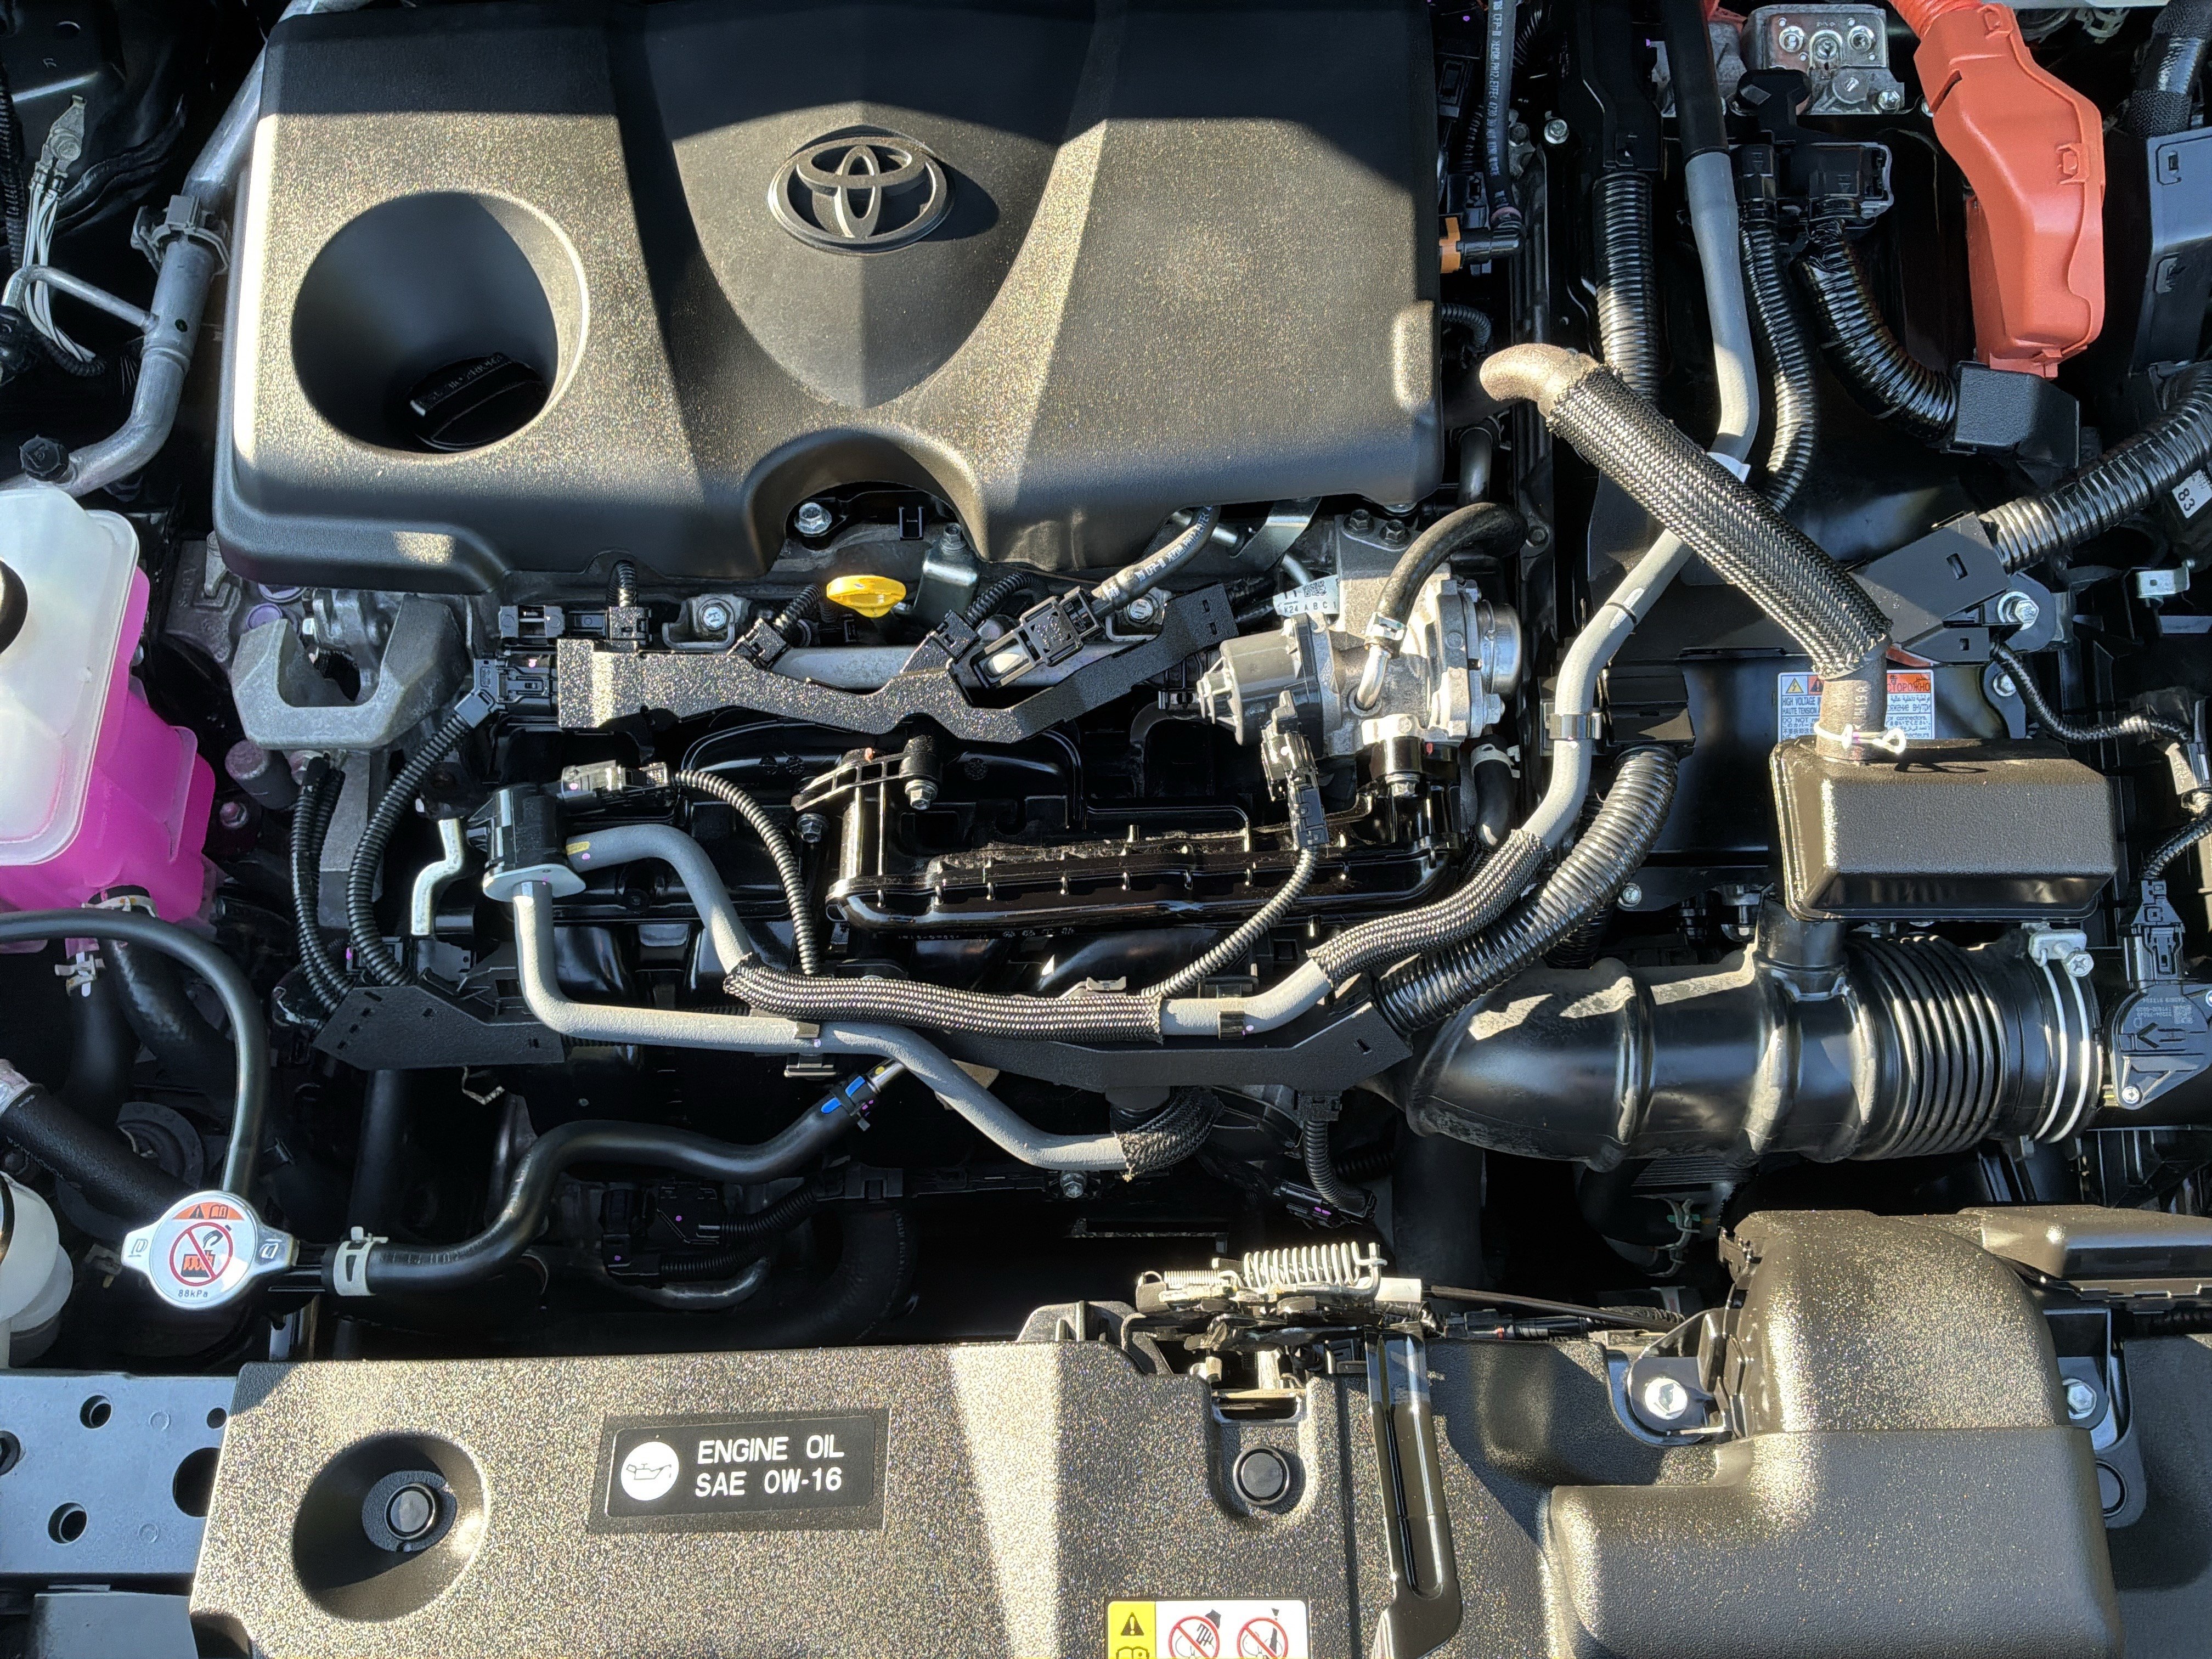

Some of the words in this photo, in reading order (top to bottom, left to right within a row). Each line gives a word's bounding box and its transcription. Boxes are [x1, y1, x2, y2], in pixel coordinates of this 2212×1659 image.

[2178, 488, 2196, 511] 83
[1284, 605, 1299, 613] K24
[1890, 675, 1898, 685] 告
[1887, 683, 1930, 692] СТОРОЖНО
[1782, 697, 1793, 706] HIGH
[1795, 697, 1815, 706] VOLTAGE
[178, 1289, 208, 1297] 88kPa
[697, 1436, 789, 1464] ENGINE
[805, 1434, 845, 1459] OIL
[695, 1471, 747, 1497] SAE
[764, 1466, 842, 1494] 0W-16
